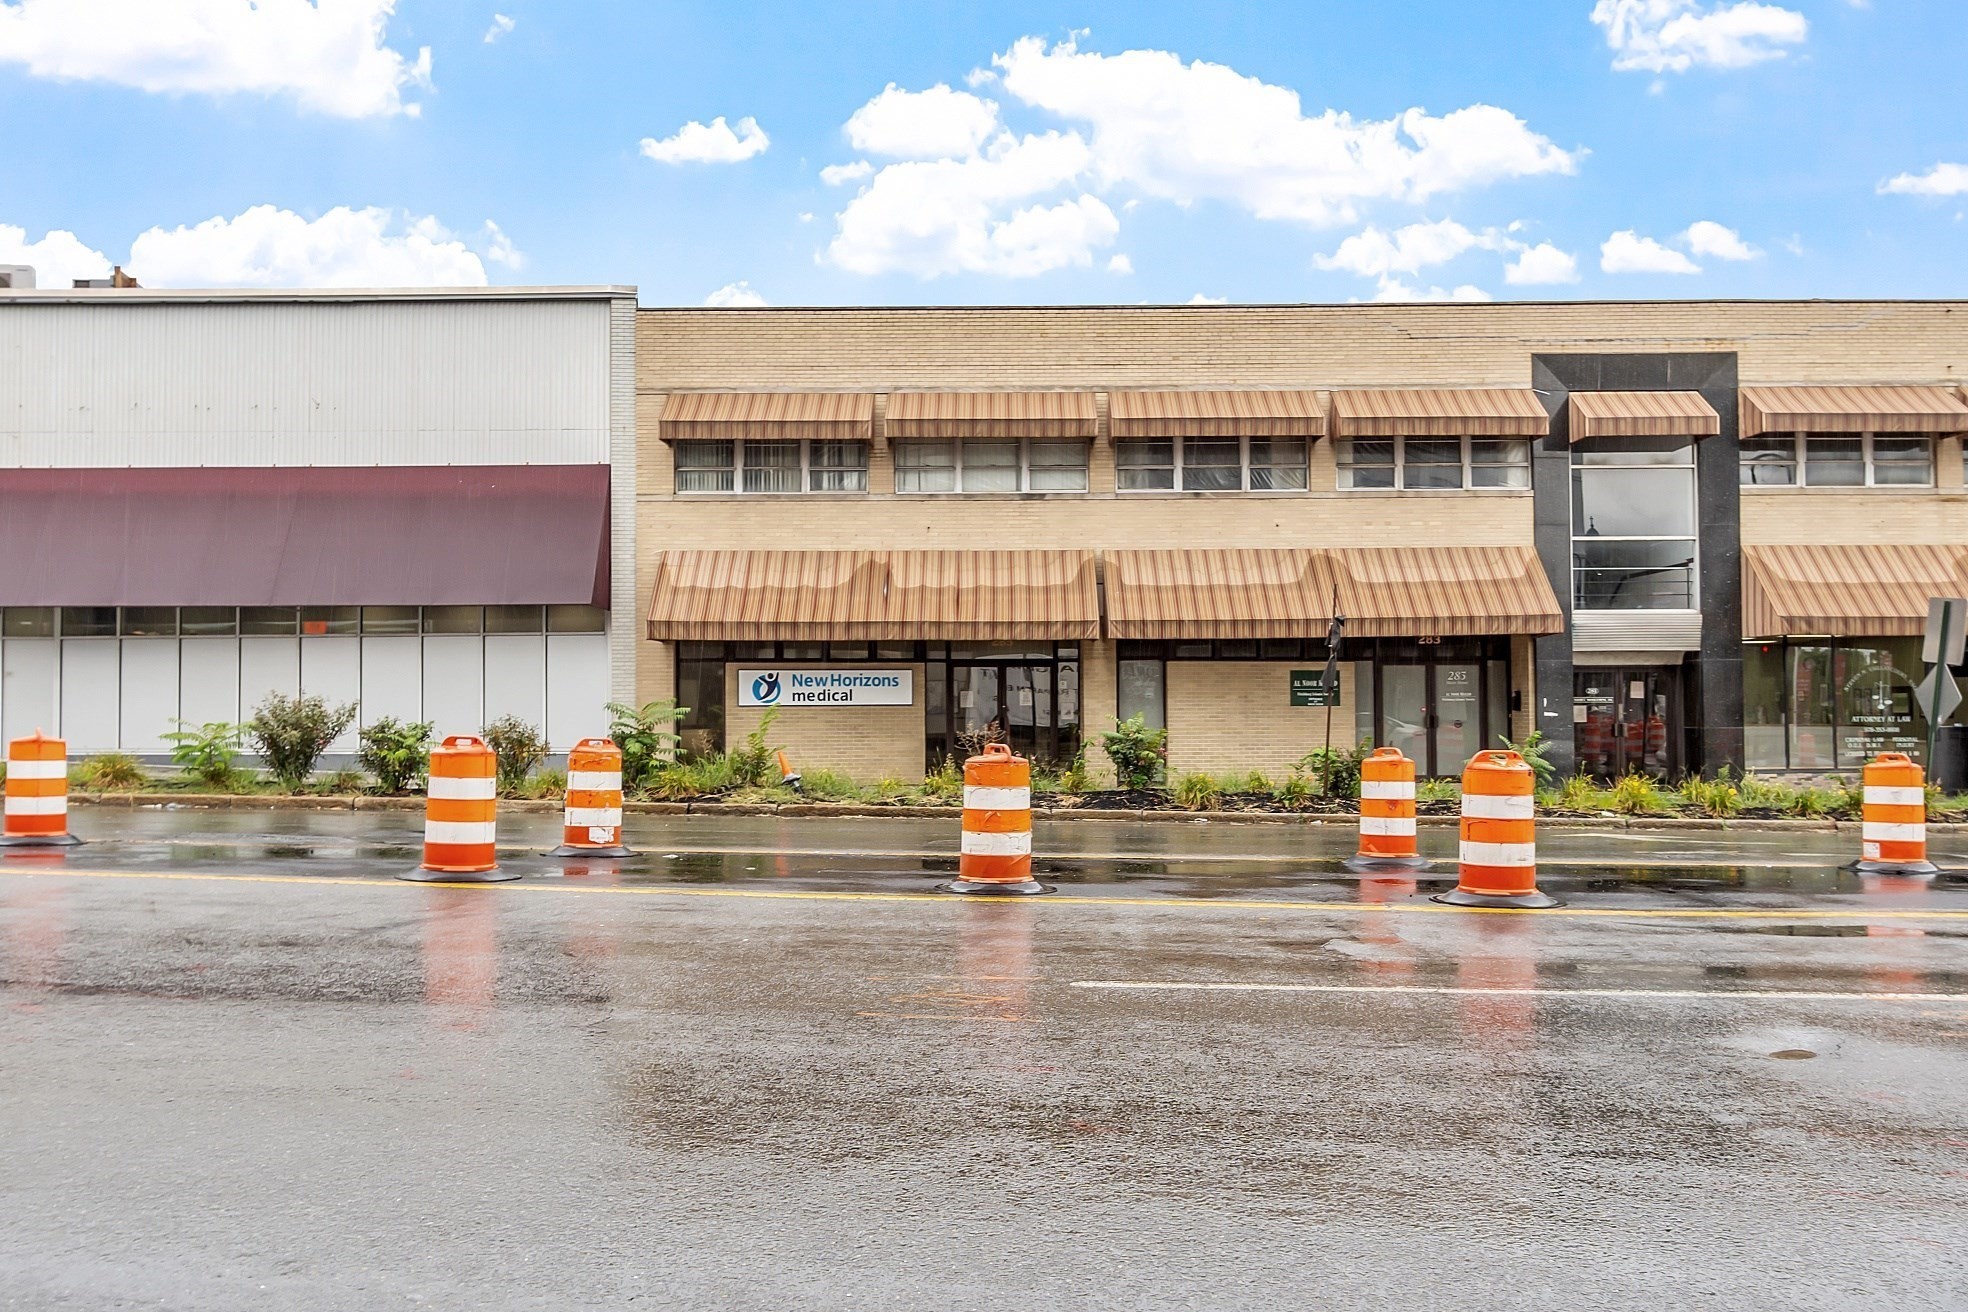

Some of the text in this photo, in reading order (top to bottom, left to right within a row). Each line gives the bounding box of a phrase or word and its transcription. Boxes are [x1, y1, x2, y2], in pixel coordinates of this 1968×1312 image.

[792, 673, 899, 687] New Horizons
[792, 689, 853, 702] medical
